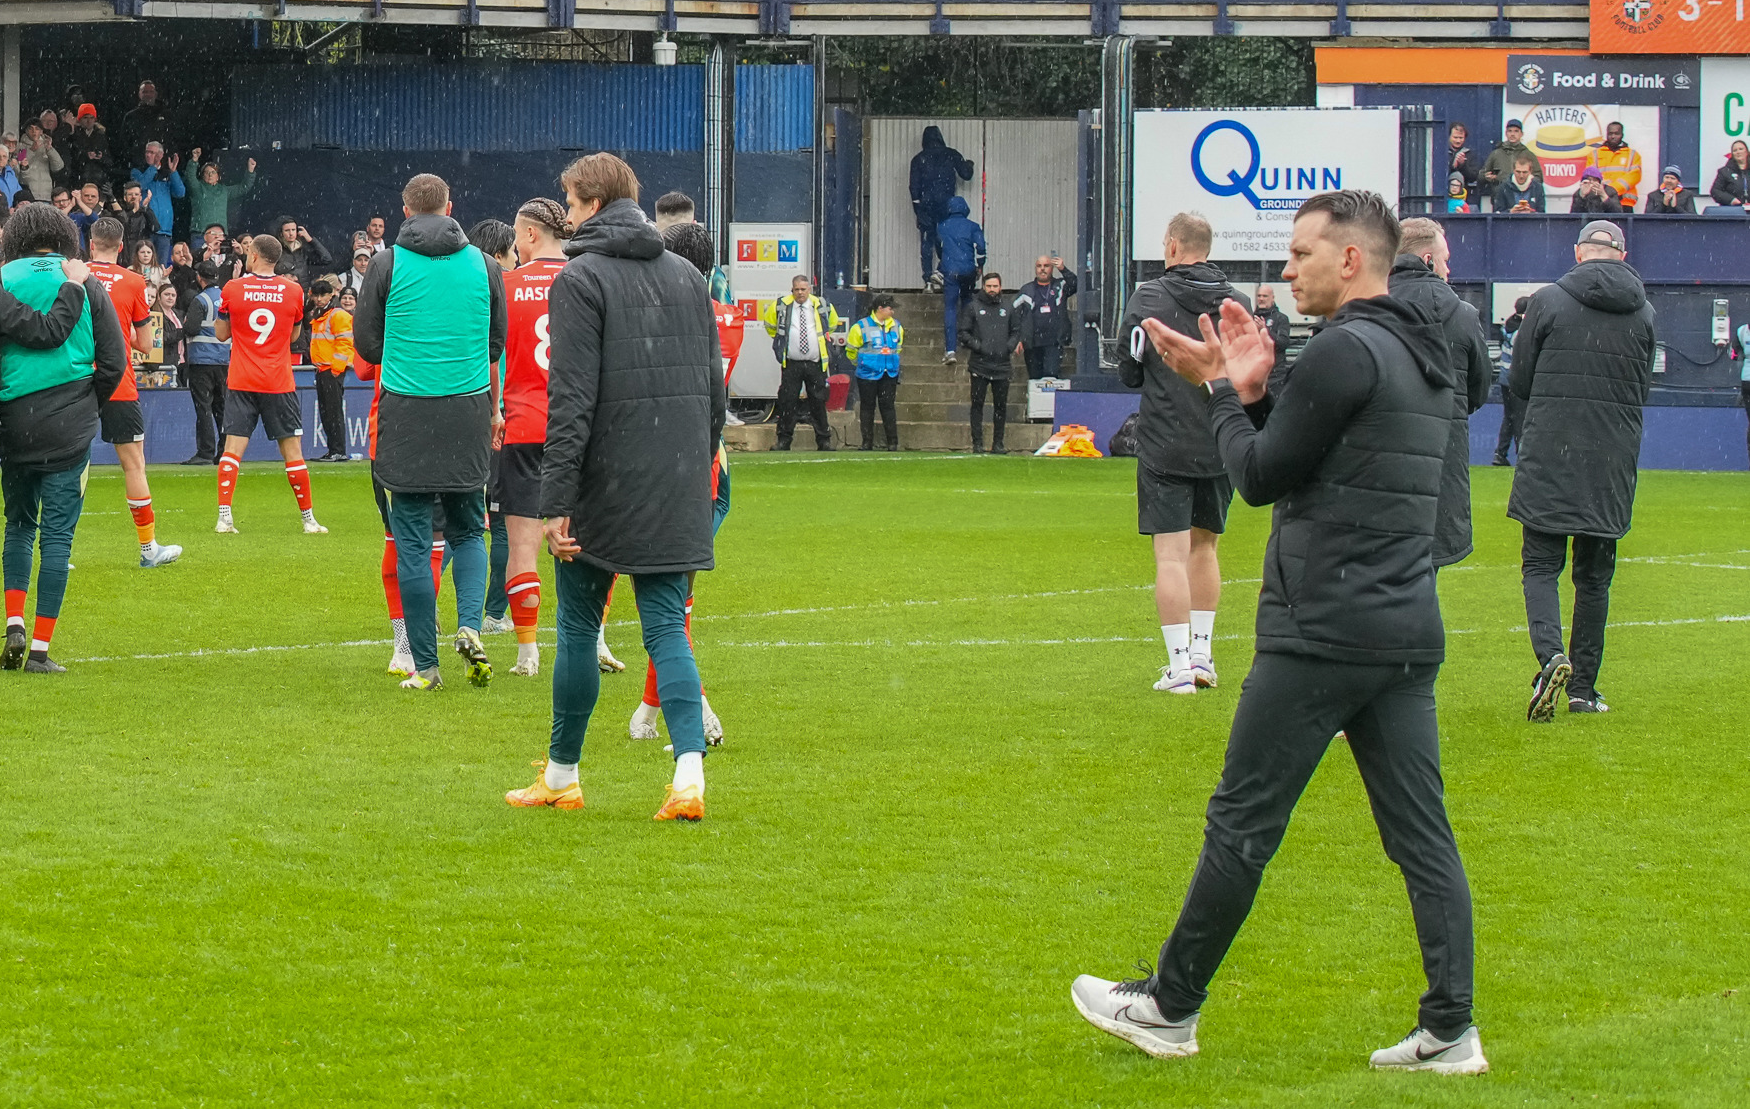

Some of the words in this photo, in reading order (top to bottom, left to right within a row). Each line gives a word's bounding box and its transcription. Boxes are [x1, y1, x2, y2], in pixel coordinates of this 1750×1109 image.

[1648, 13, 1665, 31] CLUB
[1553, 72, 1596, 88] Food
[1601, 73, 1614, 88] &
[1620, 73, 1665, 88] Drink
[1535, 107, 1587, 125] HATTERS
[1724, 92, 1750, 137] C
[1191, 119, 1341, 198] QUINN
[1544, 164, 1576, 177] TOKYO
[1232, 242, 1260, 251] 01582
[96, 271, 113, 279] Group
[244, 291, 283, 303] MORRIS
[248, 308, 276, 345] 9
